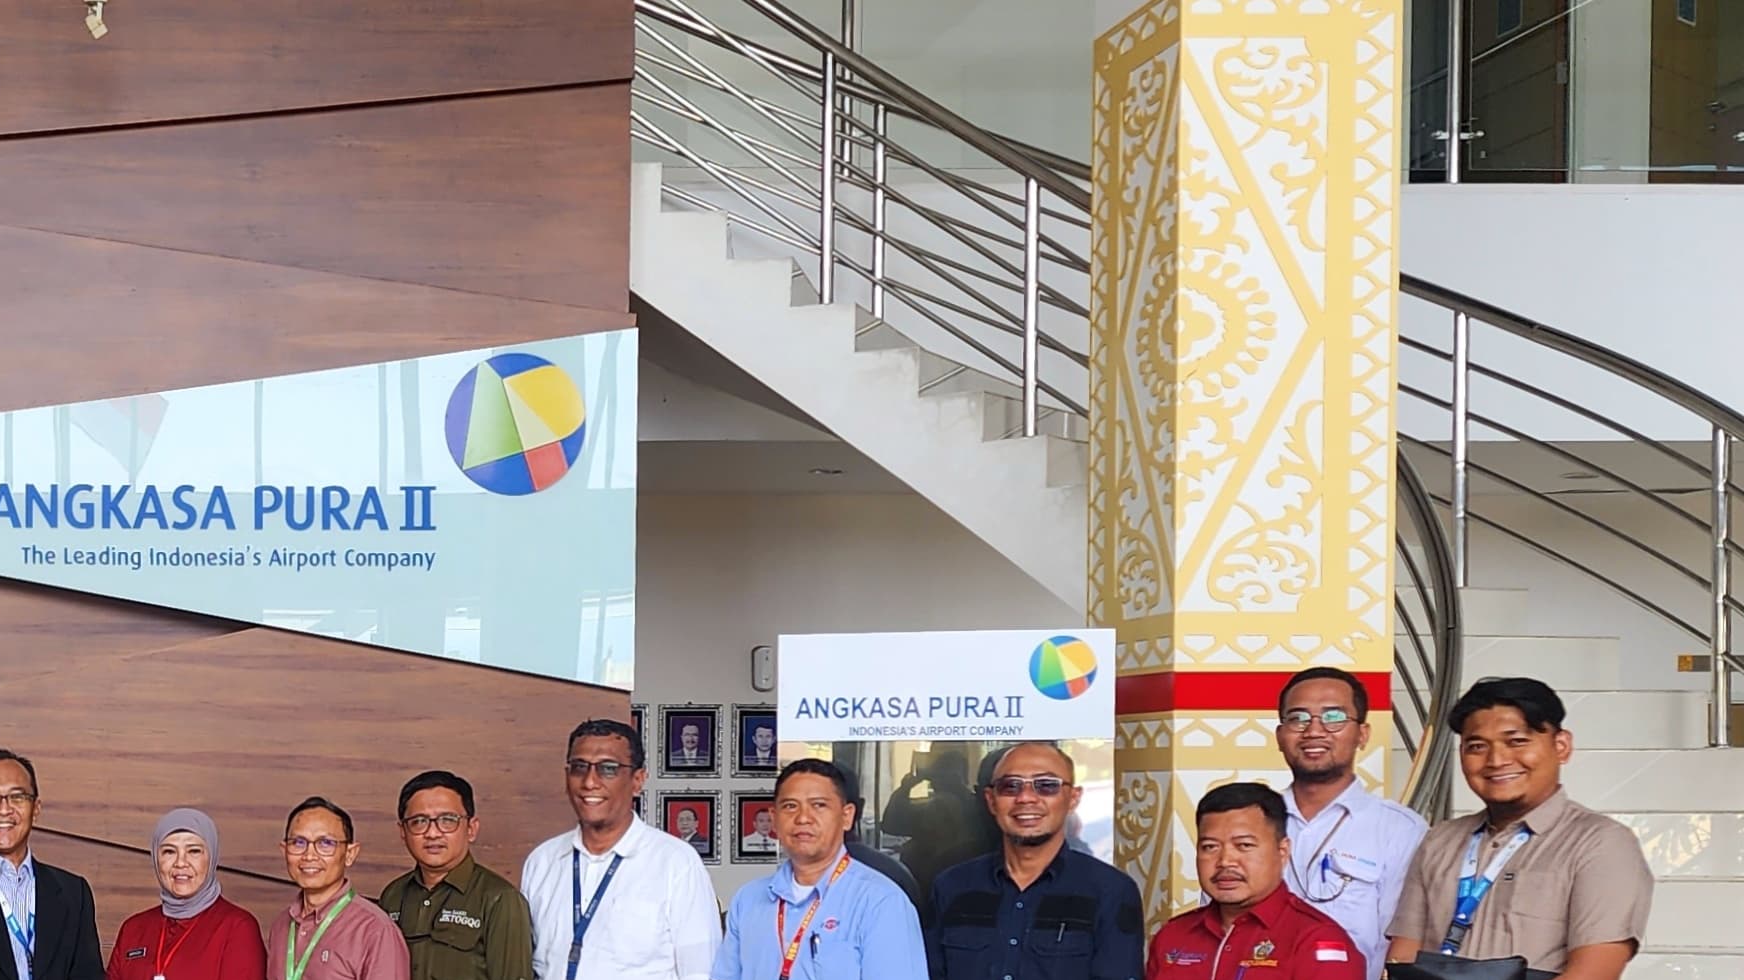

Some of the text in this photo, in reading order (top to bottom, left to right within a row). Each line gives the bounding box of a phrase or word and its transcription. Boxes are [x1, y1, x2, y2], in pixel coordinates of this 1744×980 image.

[254, 485, 389, 531] PURA
[399, 486, 437, 531] II
[22, 545, 436, 572] The Leading Indonesia's Airport Company
[795, 696, 1025, 719] ANGKASA PURA II
[849, 726, 1024, 736] INDONESIA'S AIRPORT COMPANY
